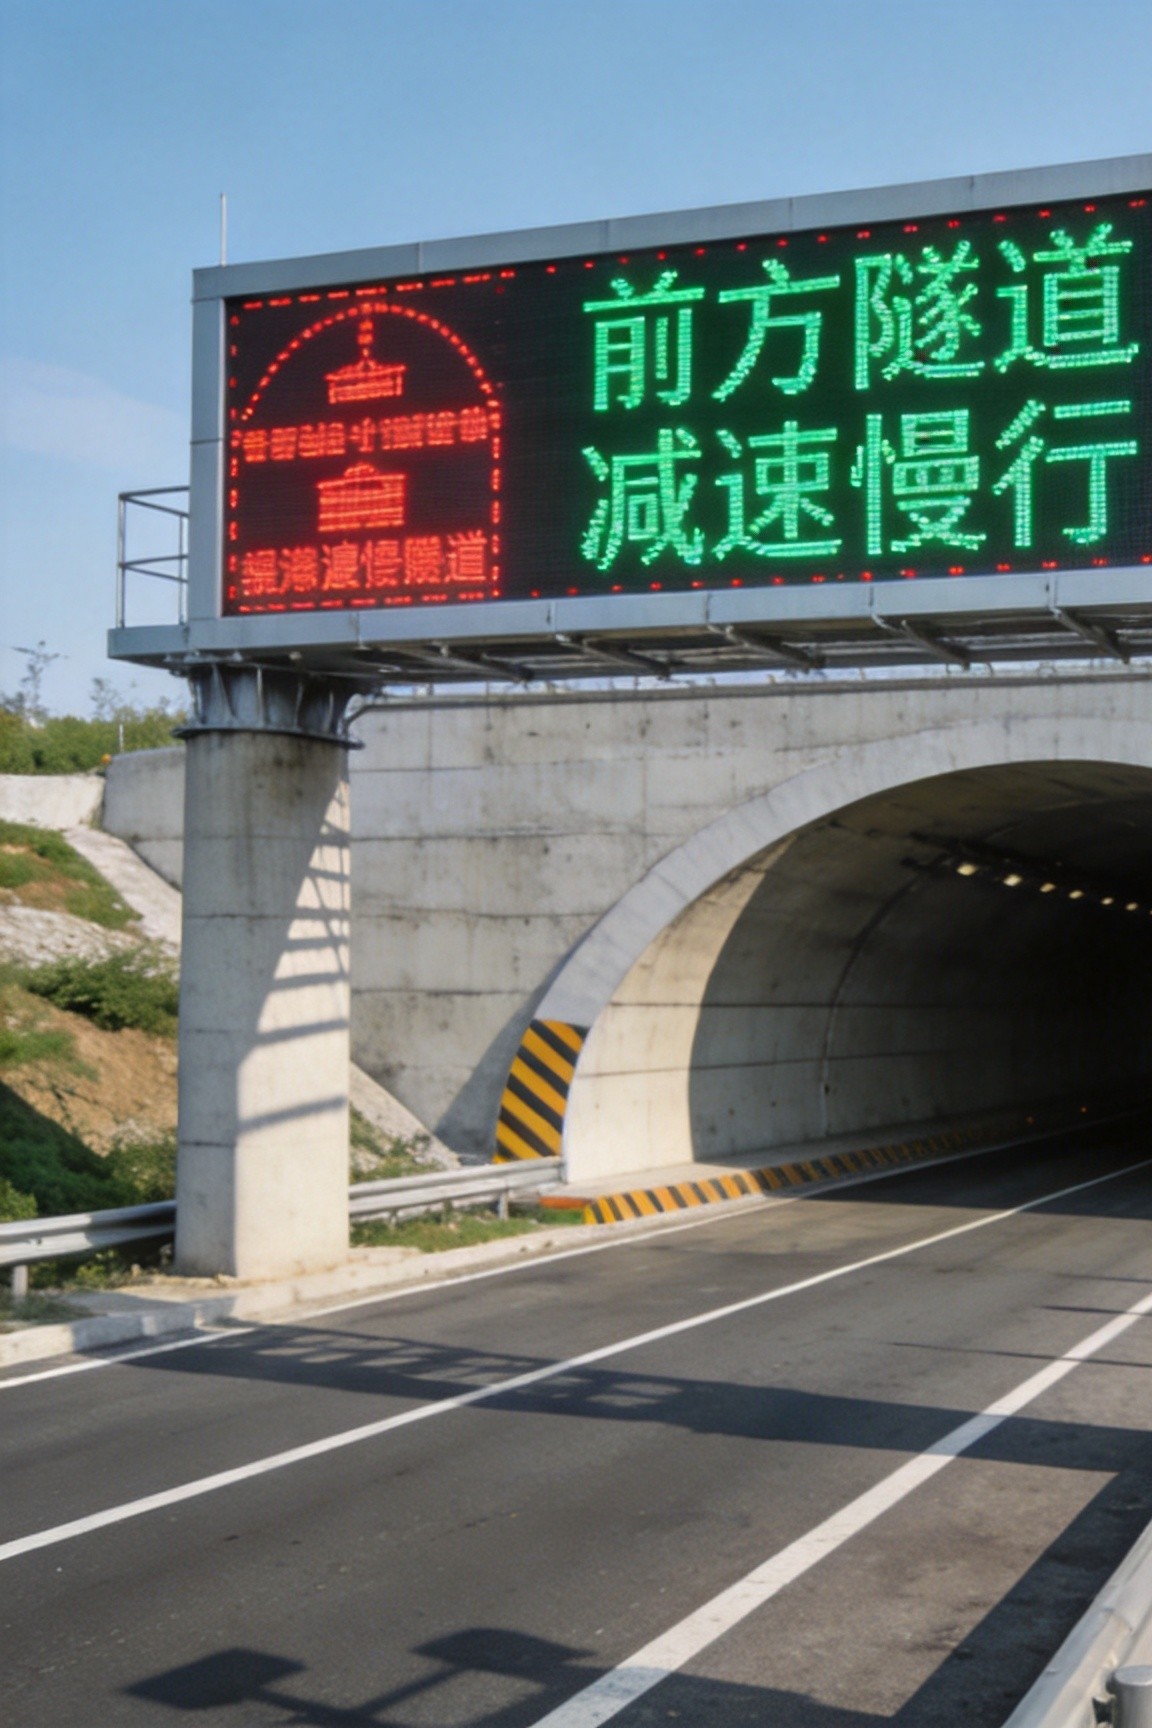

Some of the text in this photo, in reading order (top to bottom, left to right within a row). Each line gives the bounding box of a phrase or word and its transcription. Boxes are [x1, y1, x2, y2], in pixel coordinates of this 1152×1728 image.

[583, 222, 1139, 411] 前方隧道
[581, 398, 1138, 571] 减速慢行
